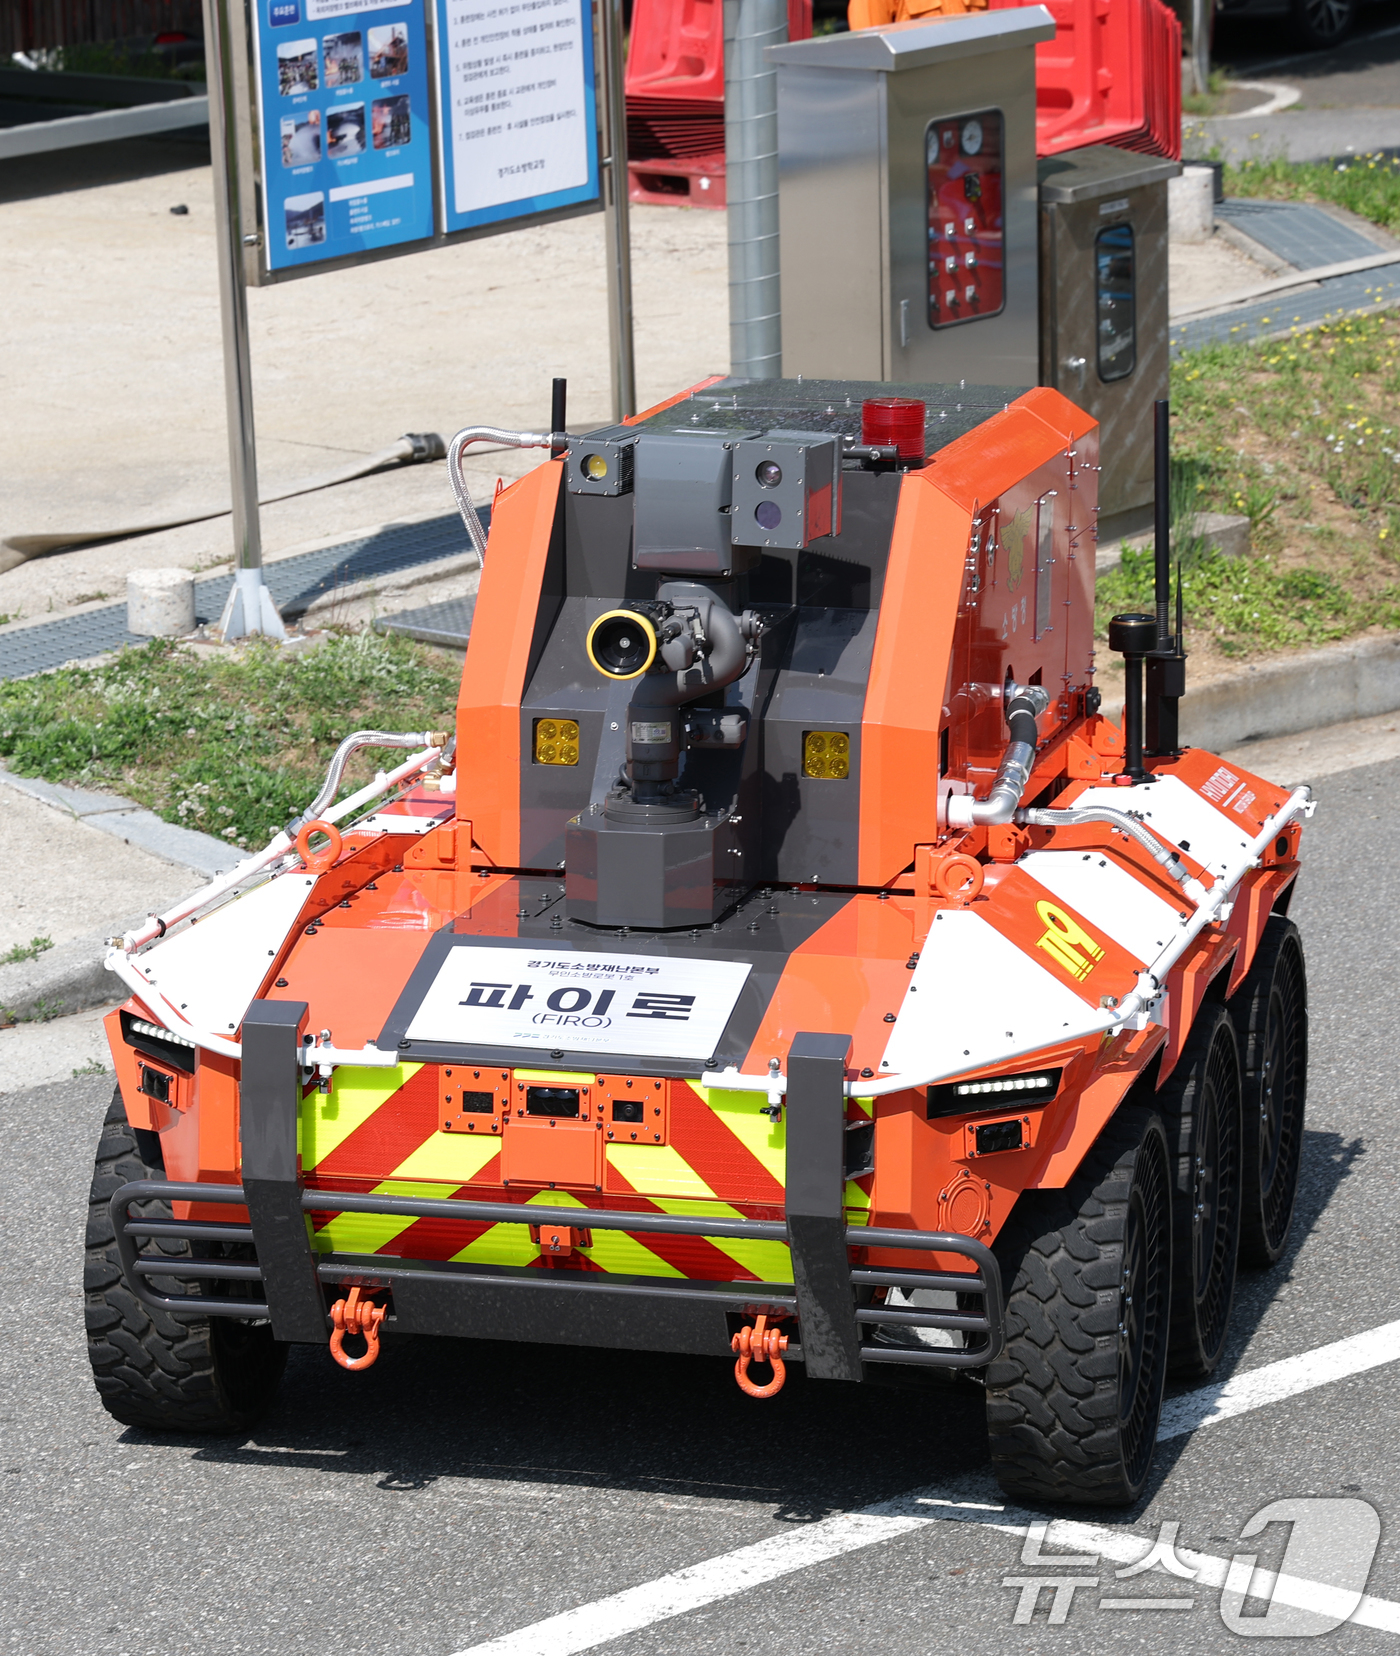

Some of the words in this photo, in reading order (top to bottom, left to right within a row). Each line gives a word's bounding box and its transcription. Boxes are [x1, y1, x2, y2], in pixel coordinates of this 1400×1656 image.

[497, 159, 546, 178] 경기도소방학교장
[1002, 595, 1027, 640] 소방청
[1199, 766, 1240, 803] HYUNDAI
[527, 960, 661, 975] 경기도소방재난본부
[458, 981, 697, 1021] 파이로
[532, 1012, 612, 1028] (FIRO)
